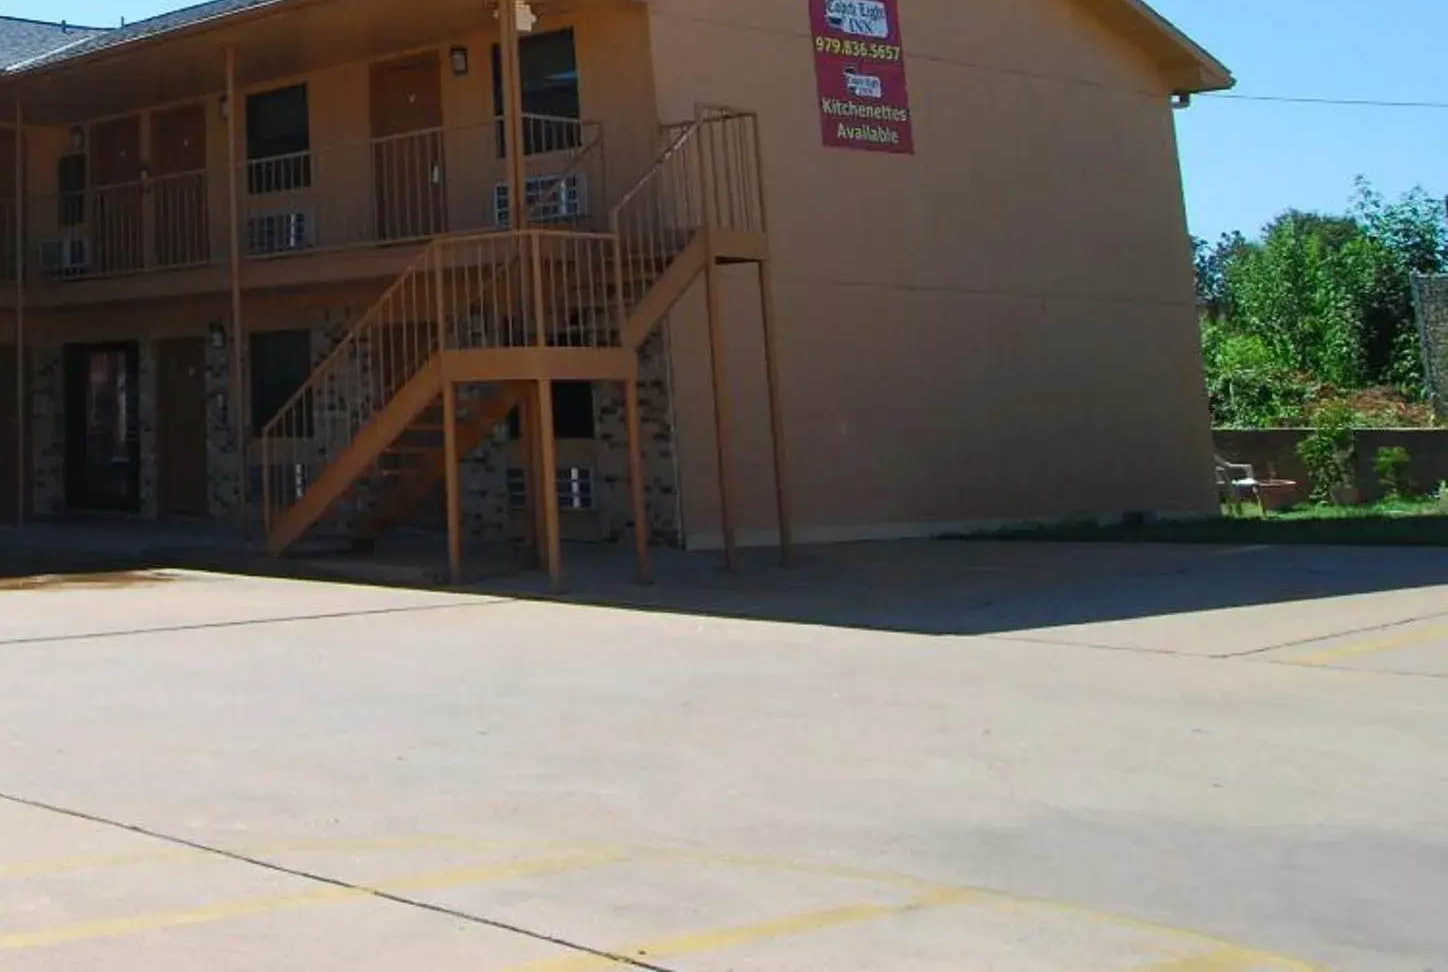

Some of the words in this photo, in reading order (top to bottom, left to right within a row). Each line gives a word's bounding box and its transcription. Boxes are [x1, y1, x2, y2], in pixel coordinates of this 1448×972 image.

[848, 17, 873, 34] INN
[821, 97, 907, 122] Kitchenettes
[837, 123, 900, 144] Available
